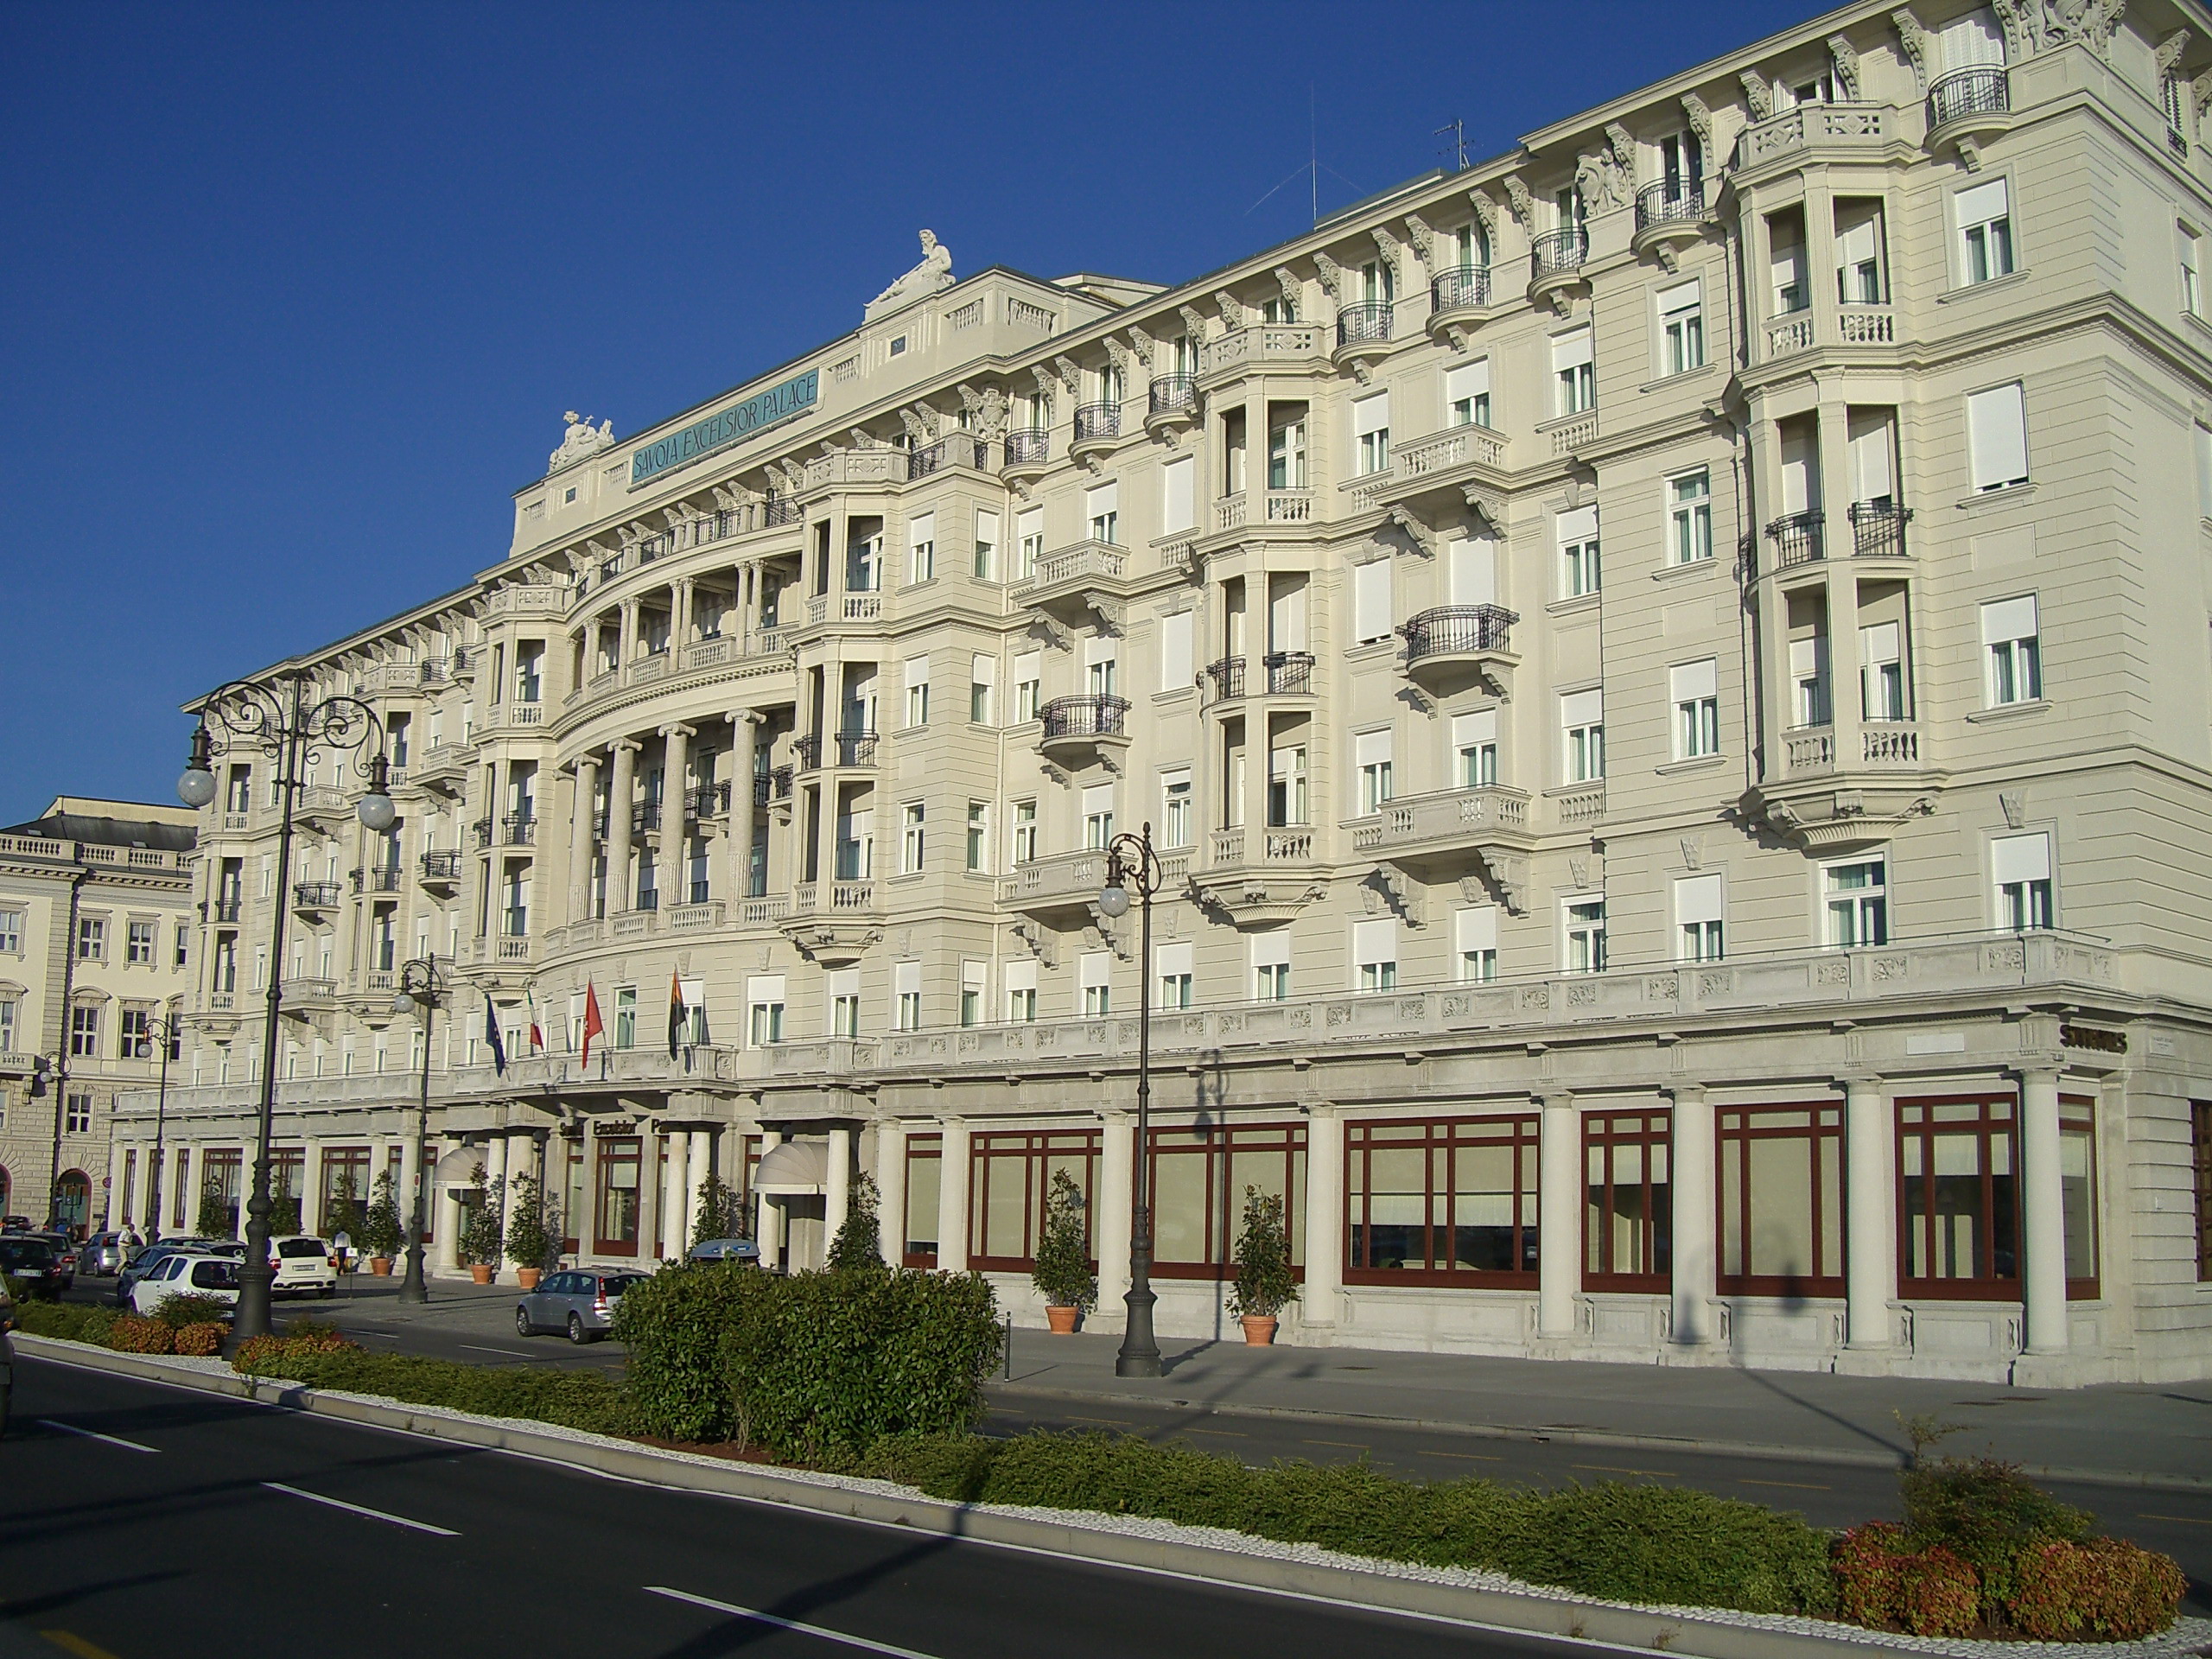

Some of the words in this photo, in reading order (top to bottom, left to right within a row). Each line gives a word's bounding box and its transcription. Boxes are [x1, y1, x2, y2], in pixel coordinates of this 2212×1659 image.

[633, 437, 678, 479] SAVOIA
[683, 401, 757, 456] EXCELSIOR
[762, 374, 816, 422] PALACE
